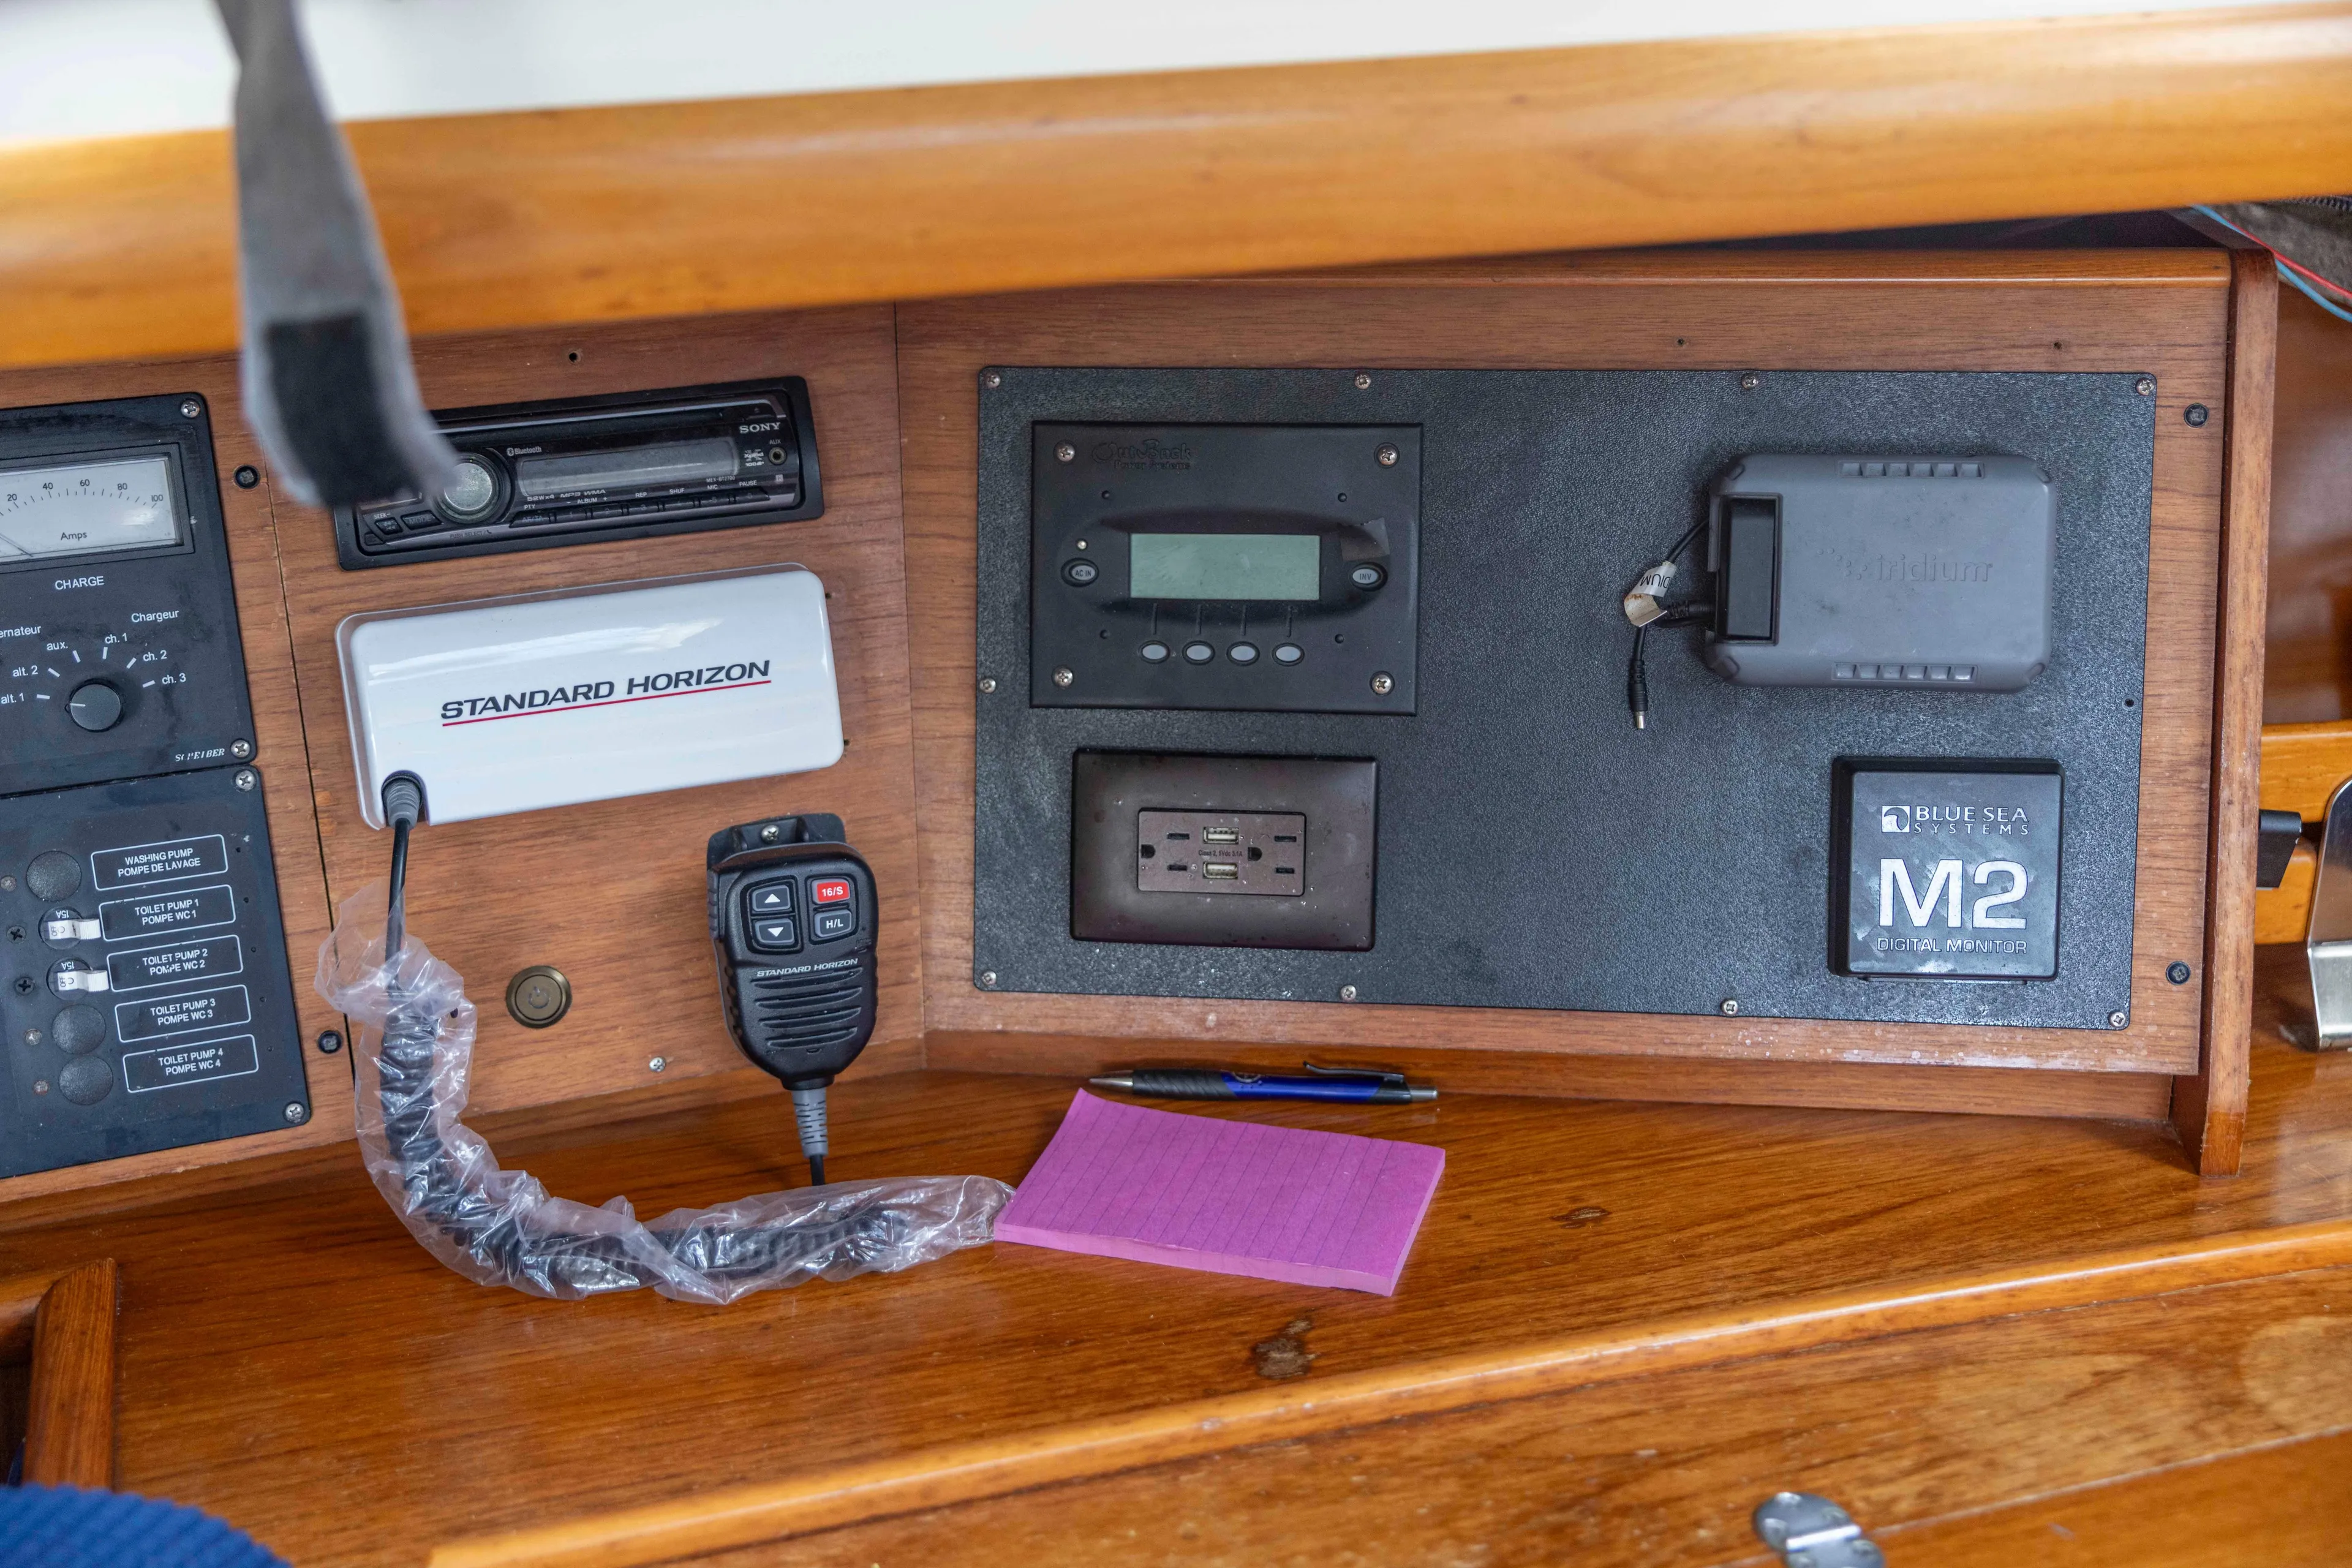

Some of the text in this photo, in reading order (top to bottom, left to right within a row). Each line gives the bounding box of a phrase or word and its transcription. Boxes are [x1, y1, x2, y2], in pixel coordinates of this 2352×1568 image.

[739, 421, 781, 434] SONY
[514, 445, 542, 454] Bluetooth
[42, 481, 53, 491] 40
[80, 478, 90, 488] 60
[117, 482, 128, 491] 80
[7, 493, 18, 502] 20
[151, 494, 164, 503] 100
[408, 516, 432, 525] MODE
[61, 531, 87, 542] Amps
[1877, 553, 1989, 582] iridium
[55, 576, 105, 590] CHARGE
[130, 610, 179, 624] Chargeur
[104, 633, 128, 644] ch. 1
[46, 641, 69, 651] aux.
[143, 650, 168, 662] ch. 2
[12, 665, 39, 677] alt. 2
[162, 673, 186, 685] ch. 3
[440, 660, 771, 720] STANDARD HORIZON
[1, 693, 24, 704] alt. 1
[1915, 805, 2029, 823] BLUE SEA
[1913, 823, 2029, 835] SYSTEMS
[124, 847, 194, 865] WASHING PUMP
[118, 858, 202, 878] POMPE DE LAVAGE
[821, 886, 844, 898] 16/S
[1878, 858, 2029, 930] M2
[134, 898, 199, 916] TOILET PUMP 1
[55, 910, 70, 919] 15A
[141, 909, 197, 926] POMPE WC 1
[826, 919, 844, 929] H/L
[1877, 937, 2027, 954] DIGITAL MONITOR
[142, 948, 208, 966] TOILET PUMP 2
[61, 961, 75, 970] 15A
[149, 959, 206, 976] POMPE WC 2
[756, 958, 859, 978] STANDARD HORIZON
[150, 998, 216, 1017] TOILET PUMP 3
[157, 1009, 214, 1026] POMPE WC 3
[158, 1048, 224, 1067] TOILET PUMP 4
[165, 1059, 222, 1076] POMPE WC 4
